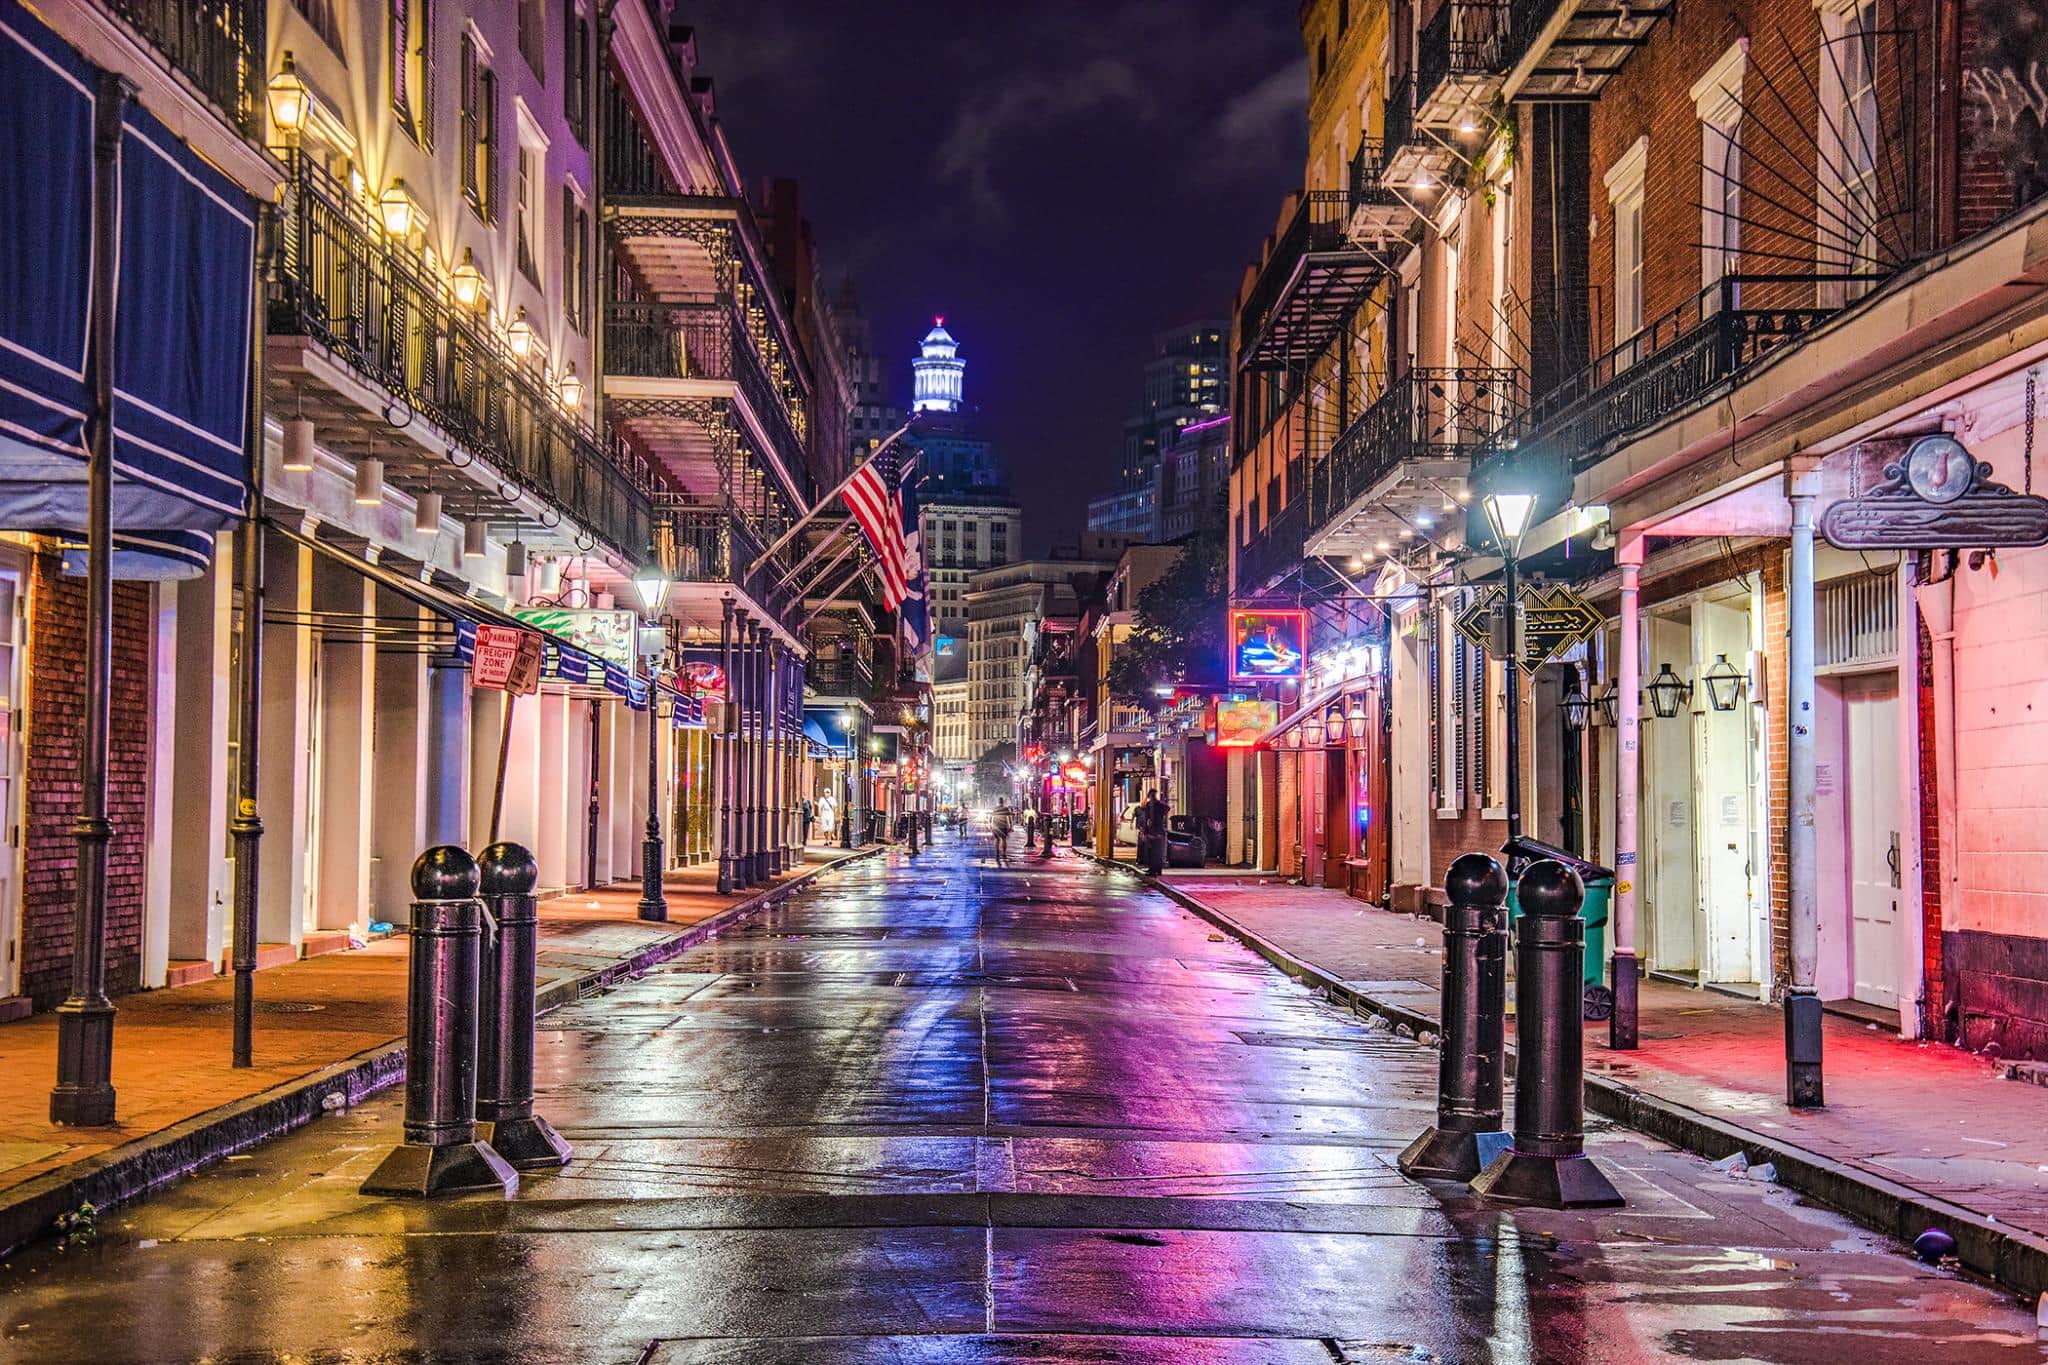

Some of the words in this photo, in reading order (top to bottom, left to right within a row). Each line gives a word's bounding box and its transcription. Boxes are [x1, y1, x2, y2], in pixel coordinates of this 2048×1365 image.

[478, 630, 490, 643] NO
[490, 632, 517, 644] PARKING
[479, 647, 513, 659] FREIGHT
[483, 657, 506, 669] ZONE
